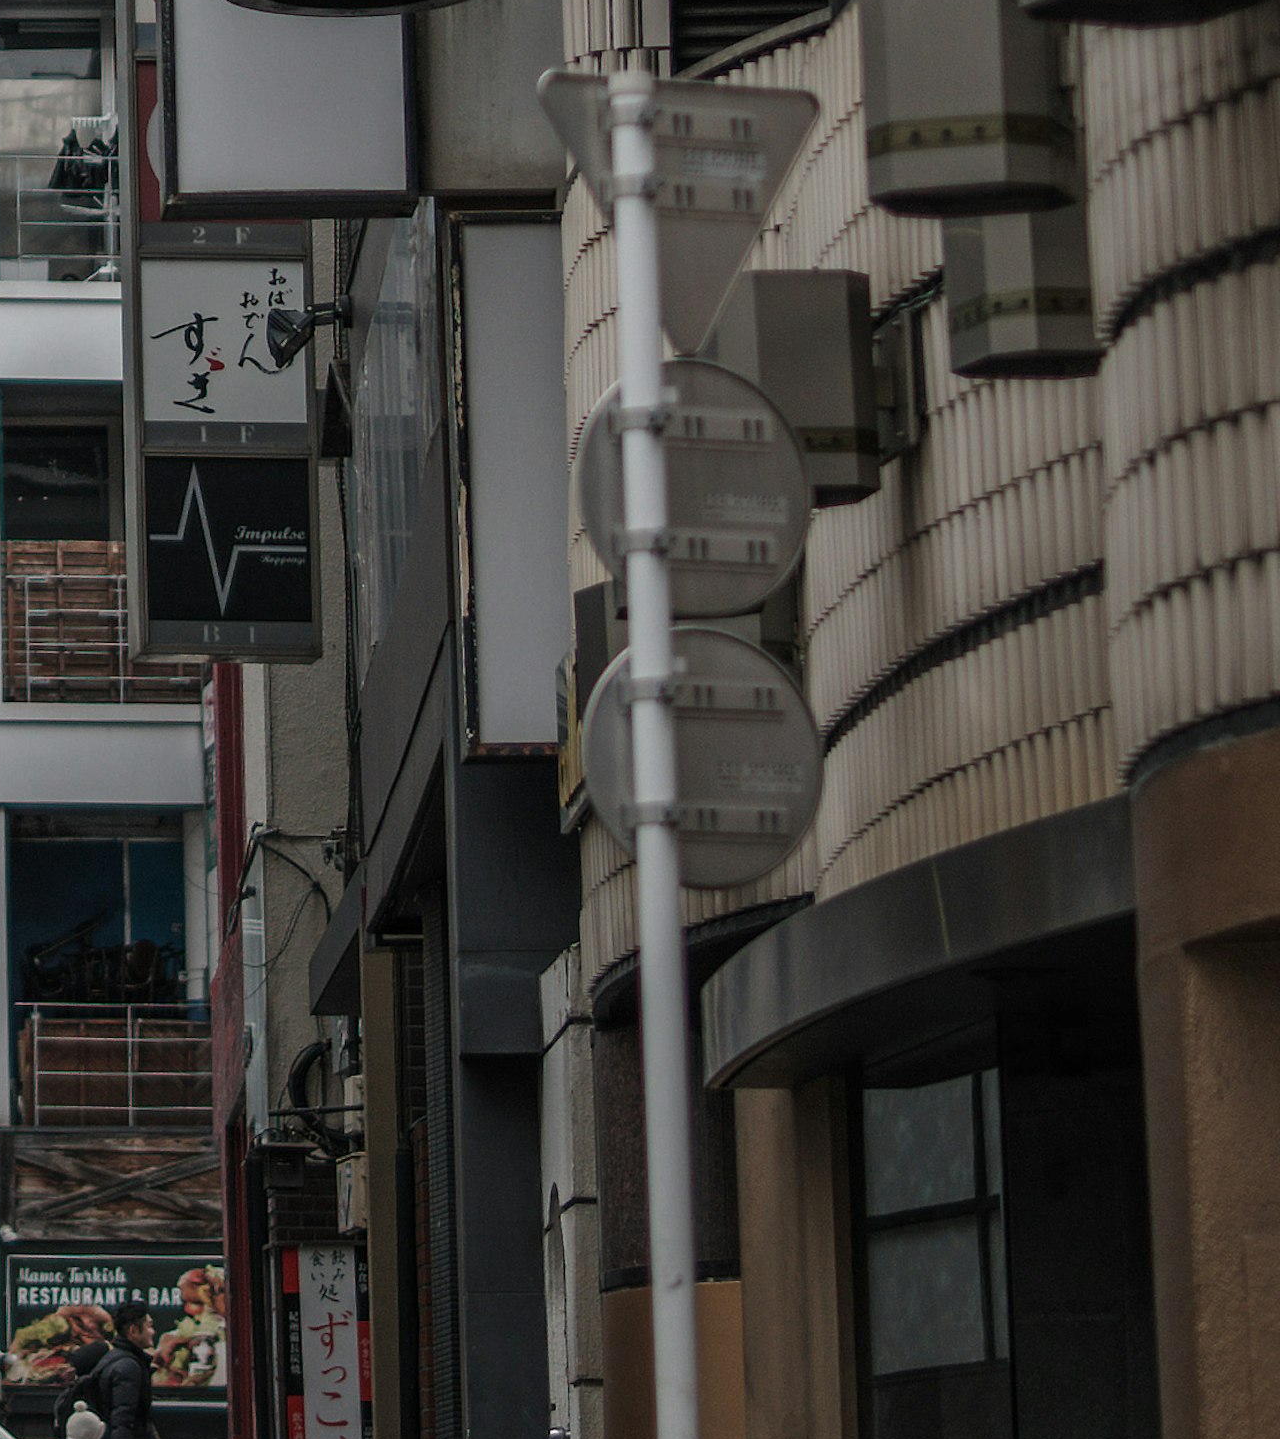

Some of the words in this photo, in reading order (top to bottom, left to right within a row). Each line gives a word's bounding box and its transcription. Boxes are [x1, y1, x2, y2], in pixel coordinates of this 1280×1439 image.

[234, 525, 307, 544] Impulse
[17, 1286, 127, 1306] RESTAURANT
[148, 1286, 183, 1306] BAR
